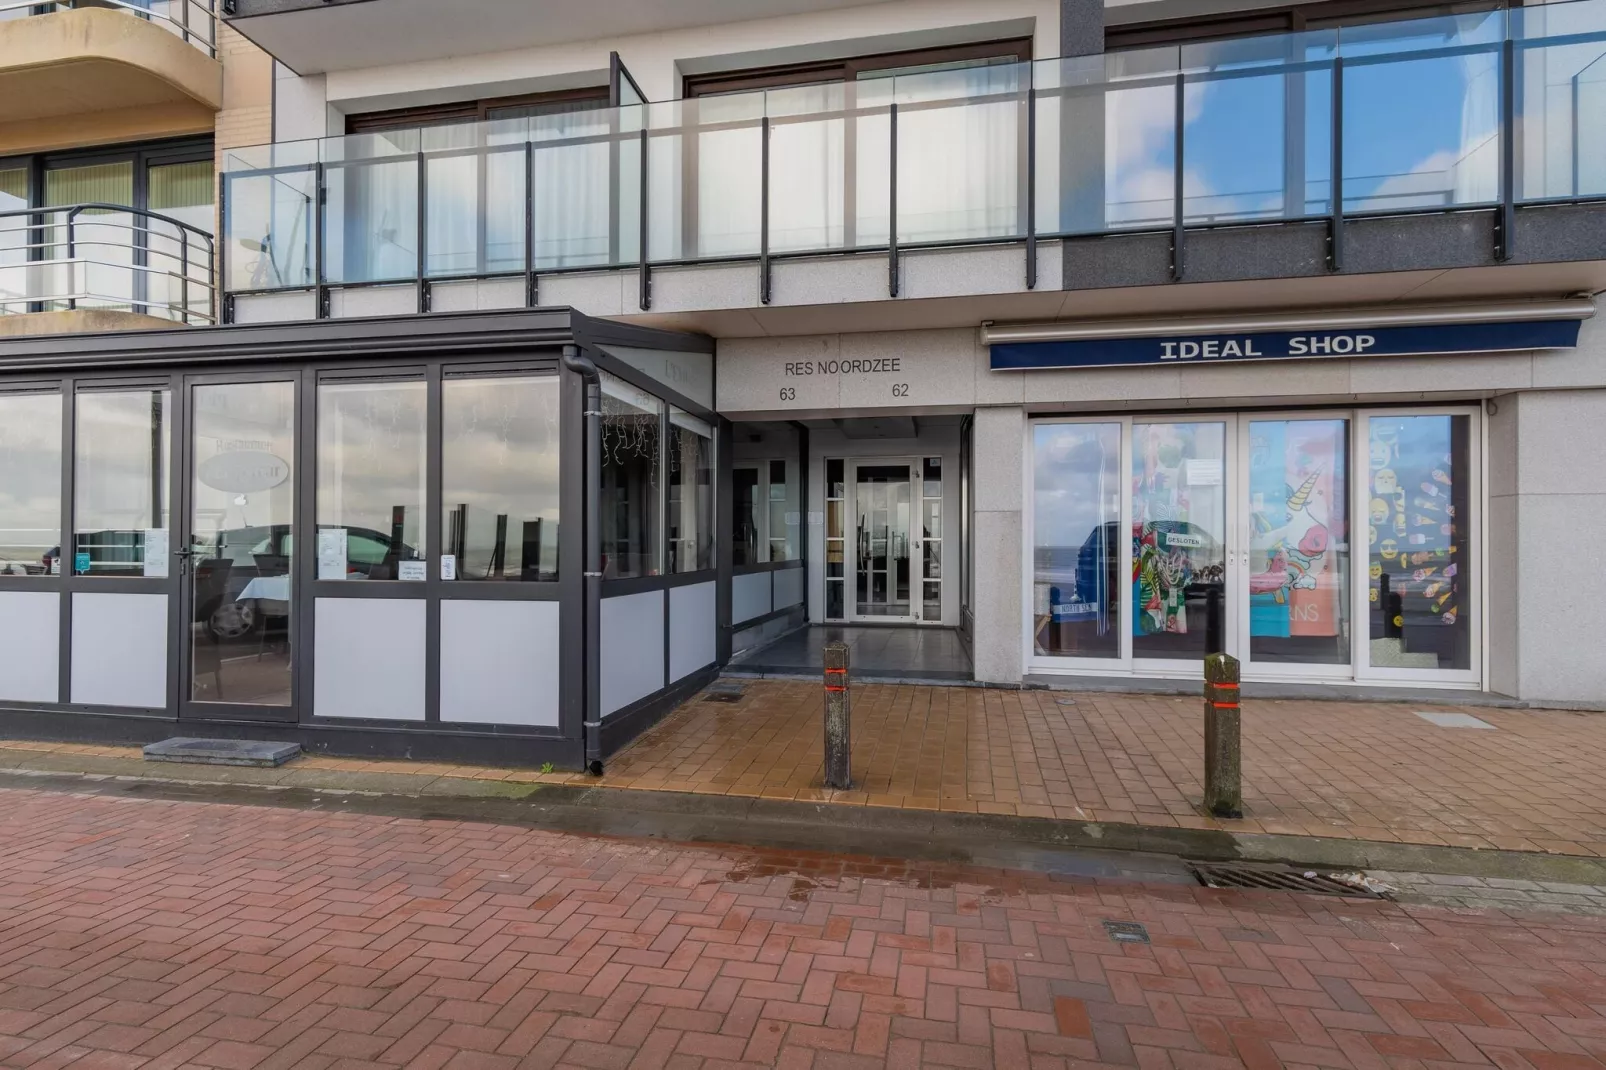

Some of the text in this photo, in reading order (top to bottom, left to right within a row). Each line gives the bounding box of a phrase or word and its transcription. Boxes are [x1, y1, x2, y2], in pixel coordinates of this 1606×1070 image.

[1160, 335, 1375, 359] IDEAL SHOP
[785, 358, 901, 376] RES NOORDZEE
[779, 387, 796, 401] 63
[892, 383, 909, 397] 62
[1167, 536, 1200, 545] GESLOTEN
